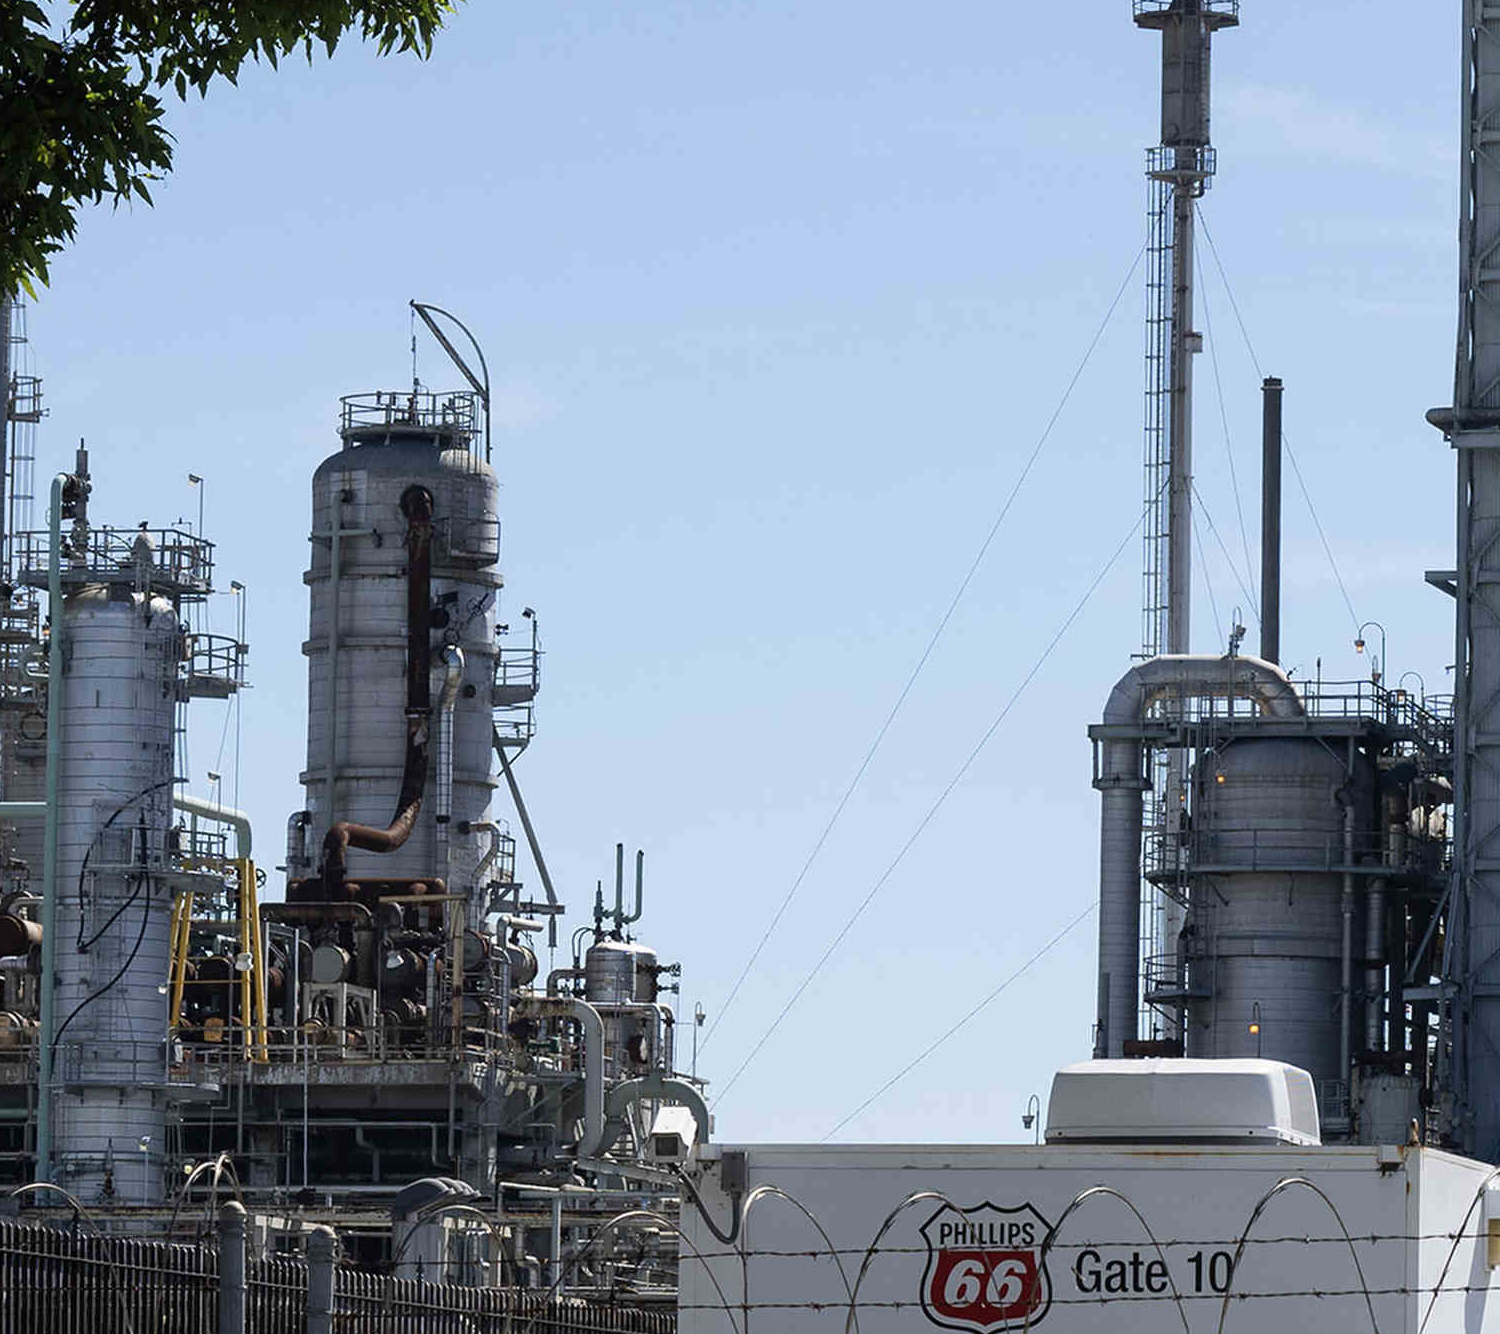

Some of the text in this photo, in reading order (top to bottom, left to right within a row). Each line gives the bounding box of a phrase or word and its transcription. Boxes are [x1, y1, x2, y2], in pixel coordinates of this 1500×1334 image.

[939, 1222, 1035, 1249] PHILLIPS
[945, 1258, 1027, 1305] 66
[1075, 1249, 1234, 1295] Gate 10
